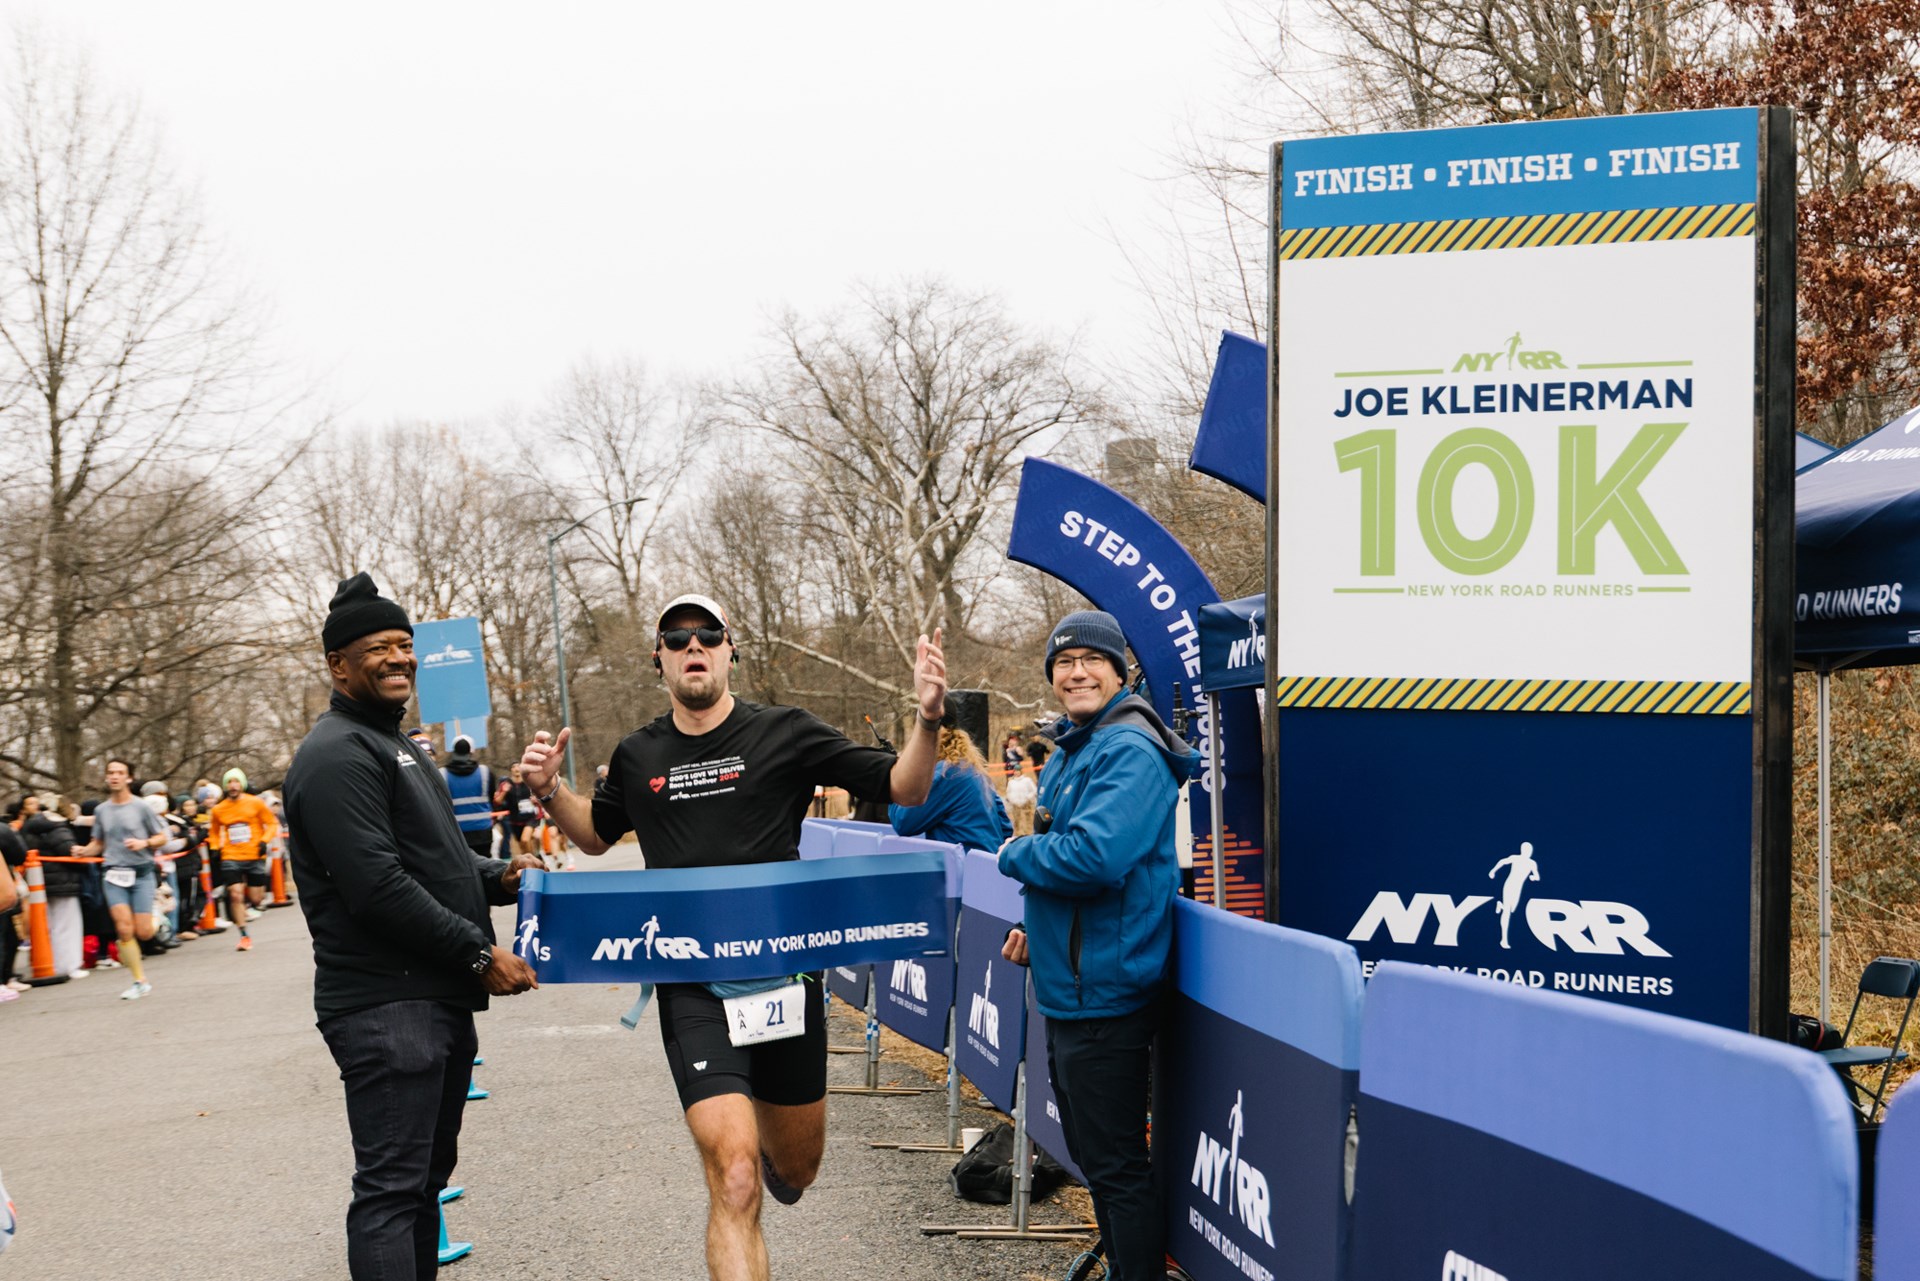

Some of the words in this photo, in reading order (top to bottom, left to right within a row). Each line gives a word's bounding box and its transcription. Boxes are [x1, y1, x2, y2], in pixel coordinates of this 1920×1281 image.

[1294, 163, 1414, 197] FINISH
[1446, 153, 1573, 188] FINISH
[1608, 142, 1741, 178] FINISH
[1333, 386, 1409, 418] JOE
[1421, 377, 1693, 415] KLEINERMAN
[1333, 422, 1691, 577] 10K
[1059, 510, 1142, 568] STEP
[1137, 562, 1177, 611] TO
[1166, 610, 1201, 679] THE
[1407, 584, 1446, 597] NEW
[1449, 584, 1495, 597] YORK
[1500, 584, 1548, 597] ROAD
[1553, 584, 1635, 597] RUNNERS
[1813, 582, 1903, 619] RUNNERS
[690, 771, 705, 779] LOVE
[720, 764, 745, 774] DELIVER
[720, 772, 739, 781] 2024
[591, 936, 710, 961] NYRR
[714, 939, 763, 958] NEW
[767, 934, 806, 954] YORK
[808, 930, 842, 949] ROAD
[844, 921, 930, 943] RUNNERS
[1346, 890, 1674, 958] NYRR
[1554, 972, 1674, 996] RUNNERS
[737, 1008, 745, 1019] A
[739, 1019, 747, 1030] A
[765, 999, 785, 1027] 21
[968, 992, 999, 1050] NYRR
[1191, 1130, 1276, 1249] NYRR
[1189, 1205, 1204, 1235] NEW
[1204, 1218, 1222, 1252] YORK
[1221, 1234, 1241, 1268] ROAD
